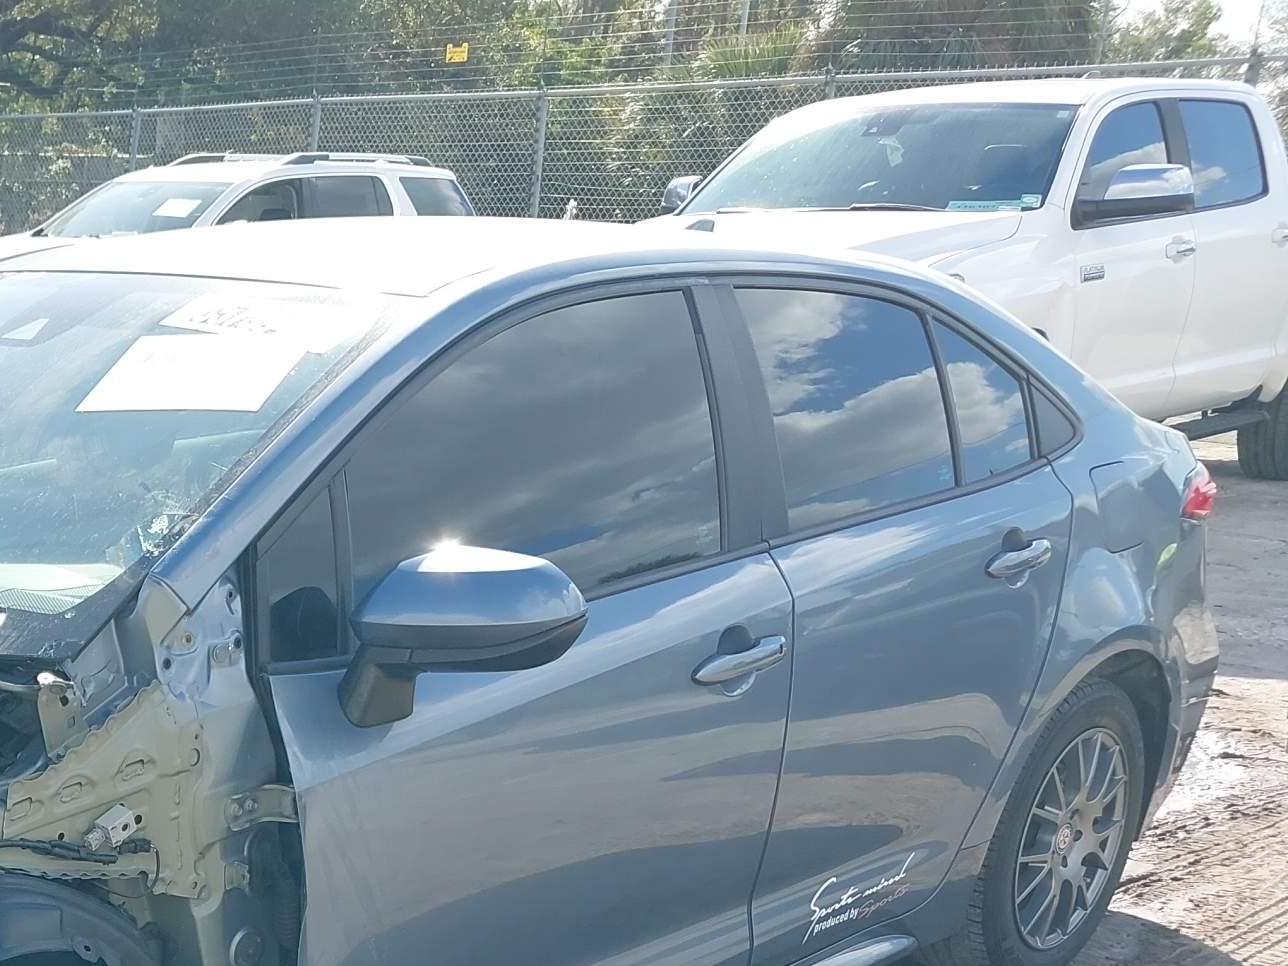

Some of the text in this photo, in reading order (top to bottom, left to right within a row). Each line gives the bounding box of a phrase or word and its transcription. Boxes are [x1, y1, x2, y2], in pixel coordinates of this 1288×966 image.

[863, 852, 915, 897] mind
[813, 883, 910, 936] produced by Sports
